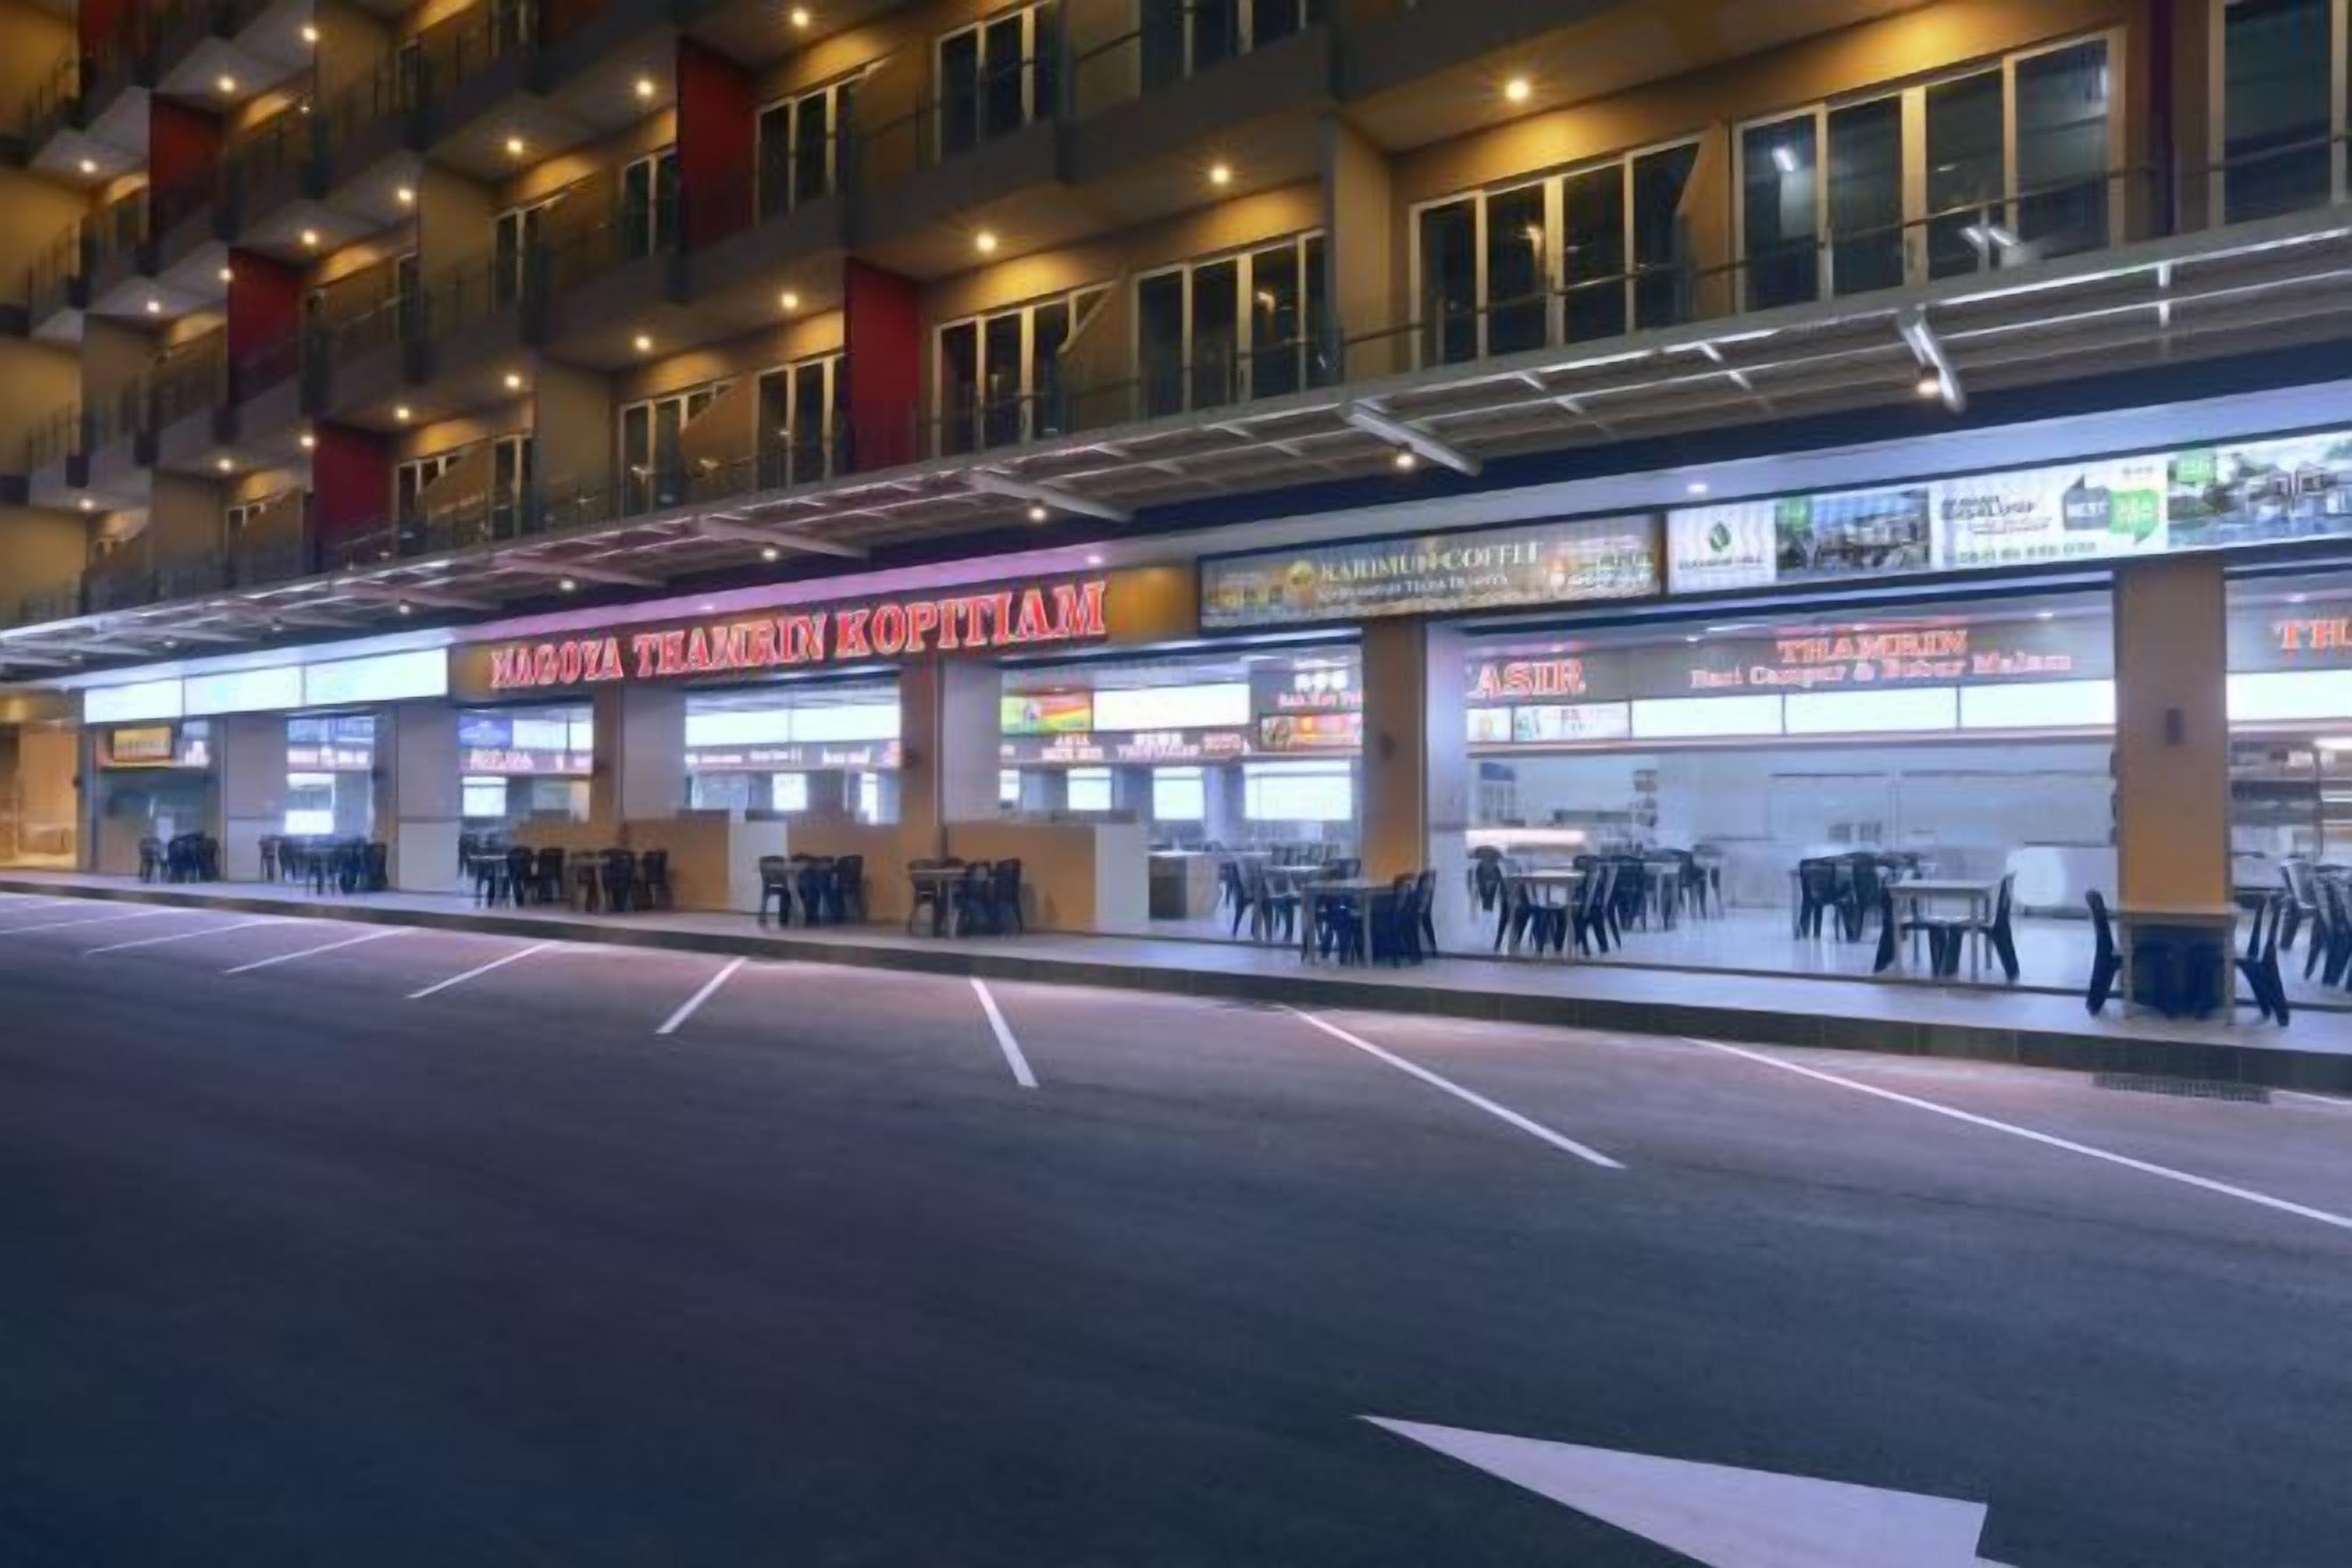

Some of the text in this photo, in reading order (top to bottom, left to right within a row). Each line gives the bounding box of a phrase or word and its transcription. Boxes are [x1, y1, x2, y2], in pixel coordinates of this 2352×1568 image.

[491, 580, 1107, 688] NAGOYA THAMRIN KOPITIAM
[1776, 629, 1968, 663] THAMRIN
[1466, 659, 1586, 699] ASIR
